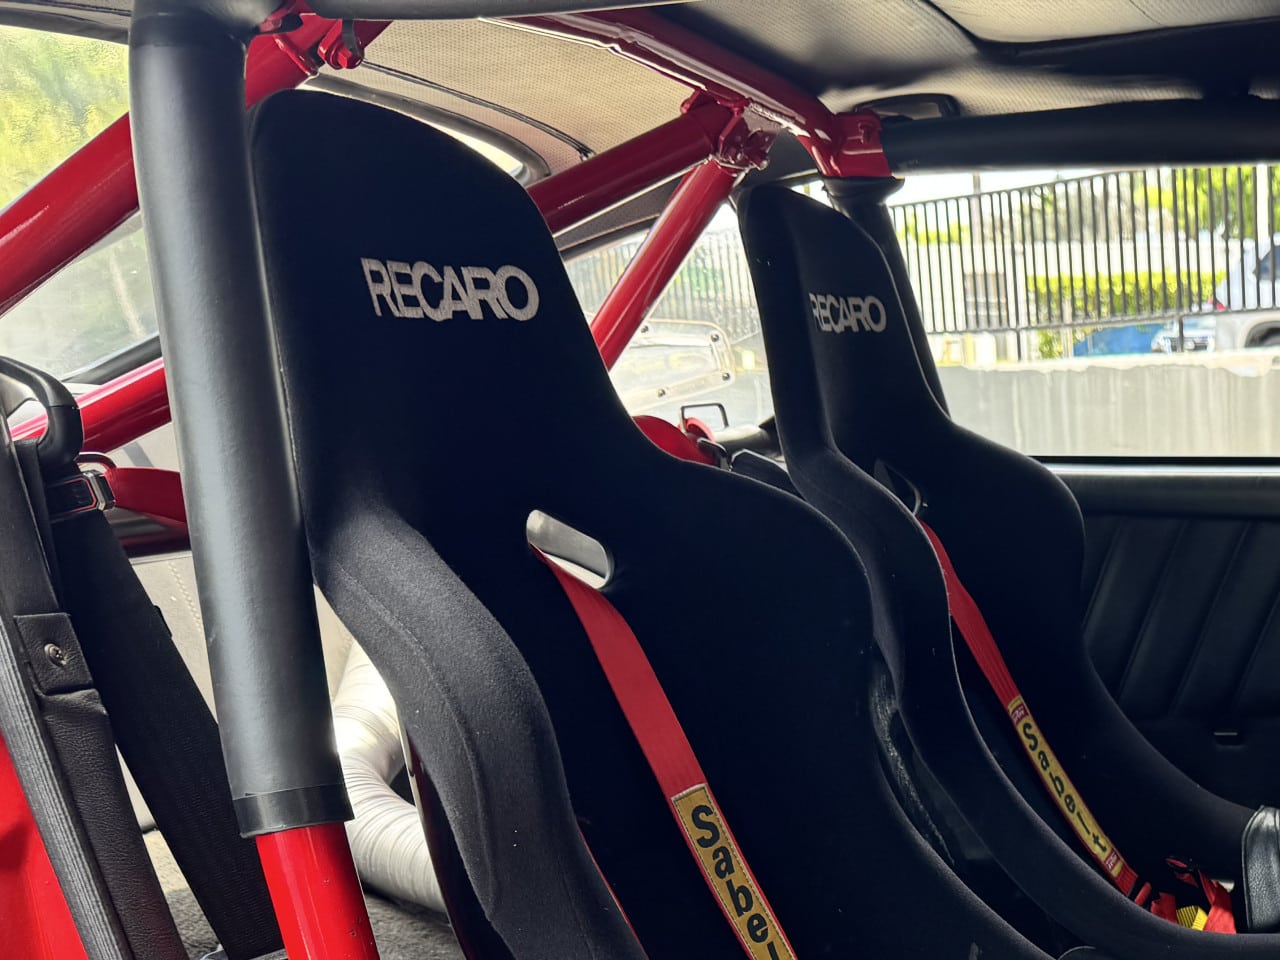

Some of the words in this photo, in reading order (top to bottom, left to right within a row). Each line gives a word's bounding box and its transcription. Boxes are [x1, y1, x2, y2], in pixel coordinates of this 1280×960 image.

[361, 257, 540, 322] RECARO
[808, 292, 887, 334] RECARO
[1022, 722, 1107, 852] Sabelt
